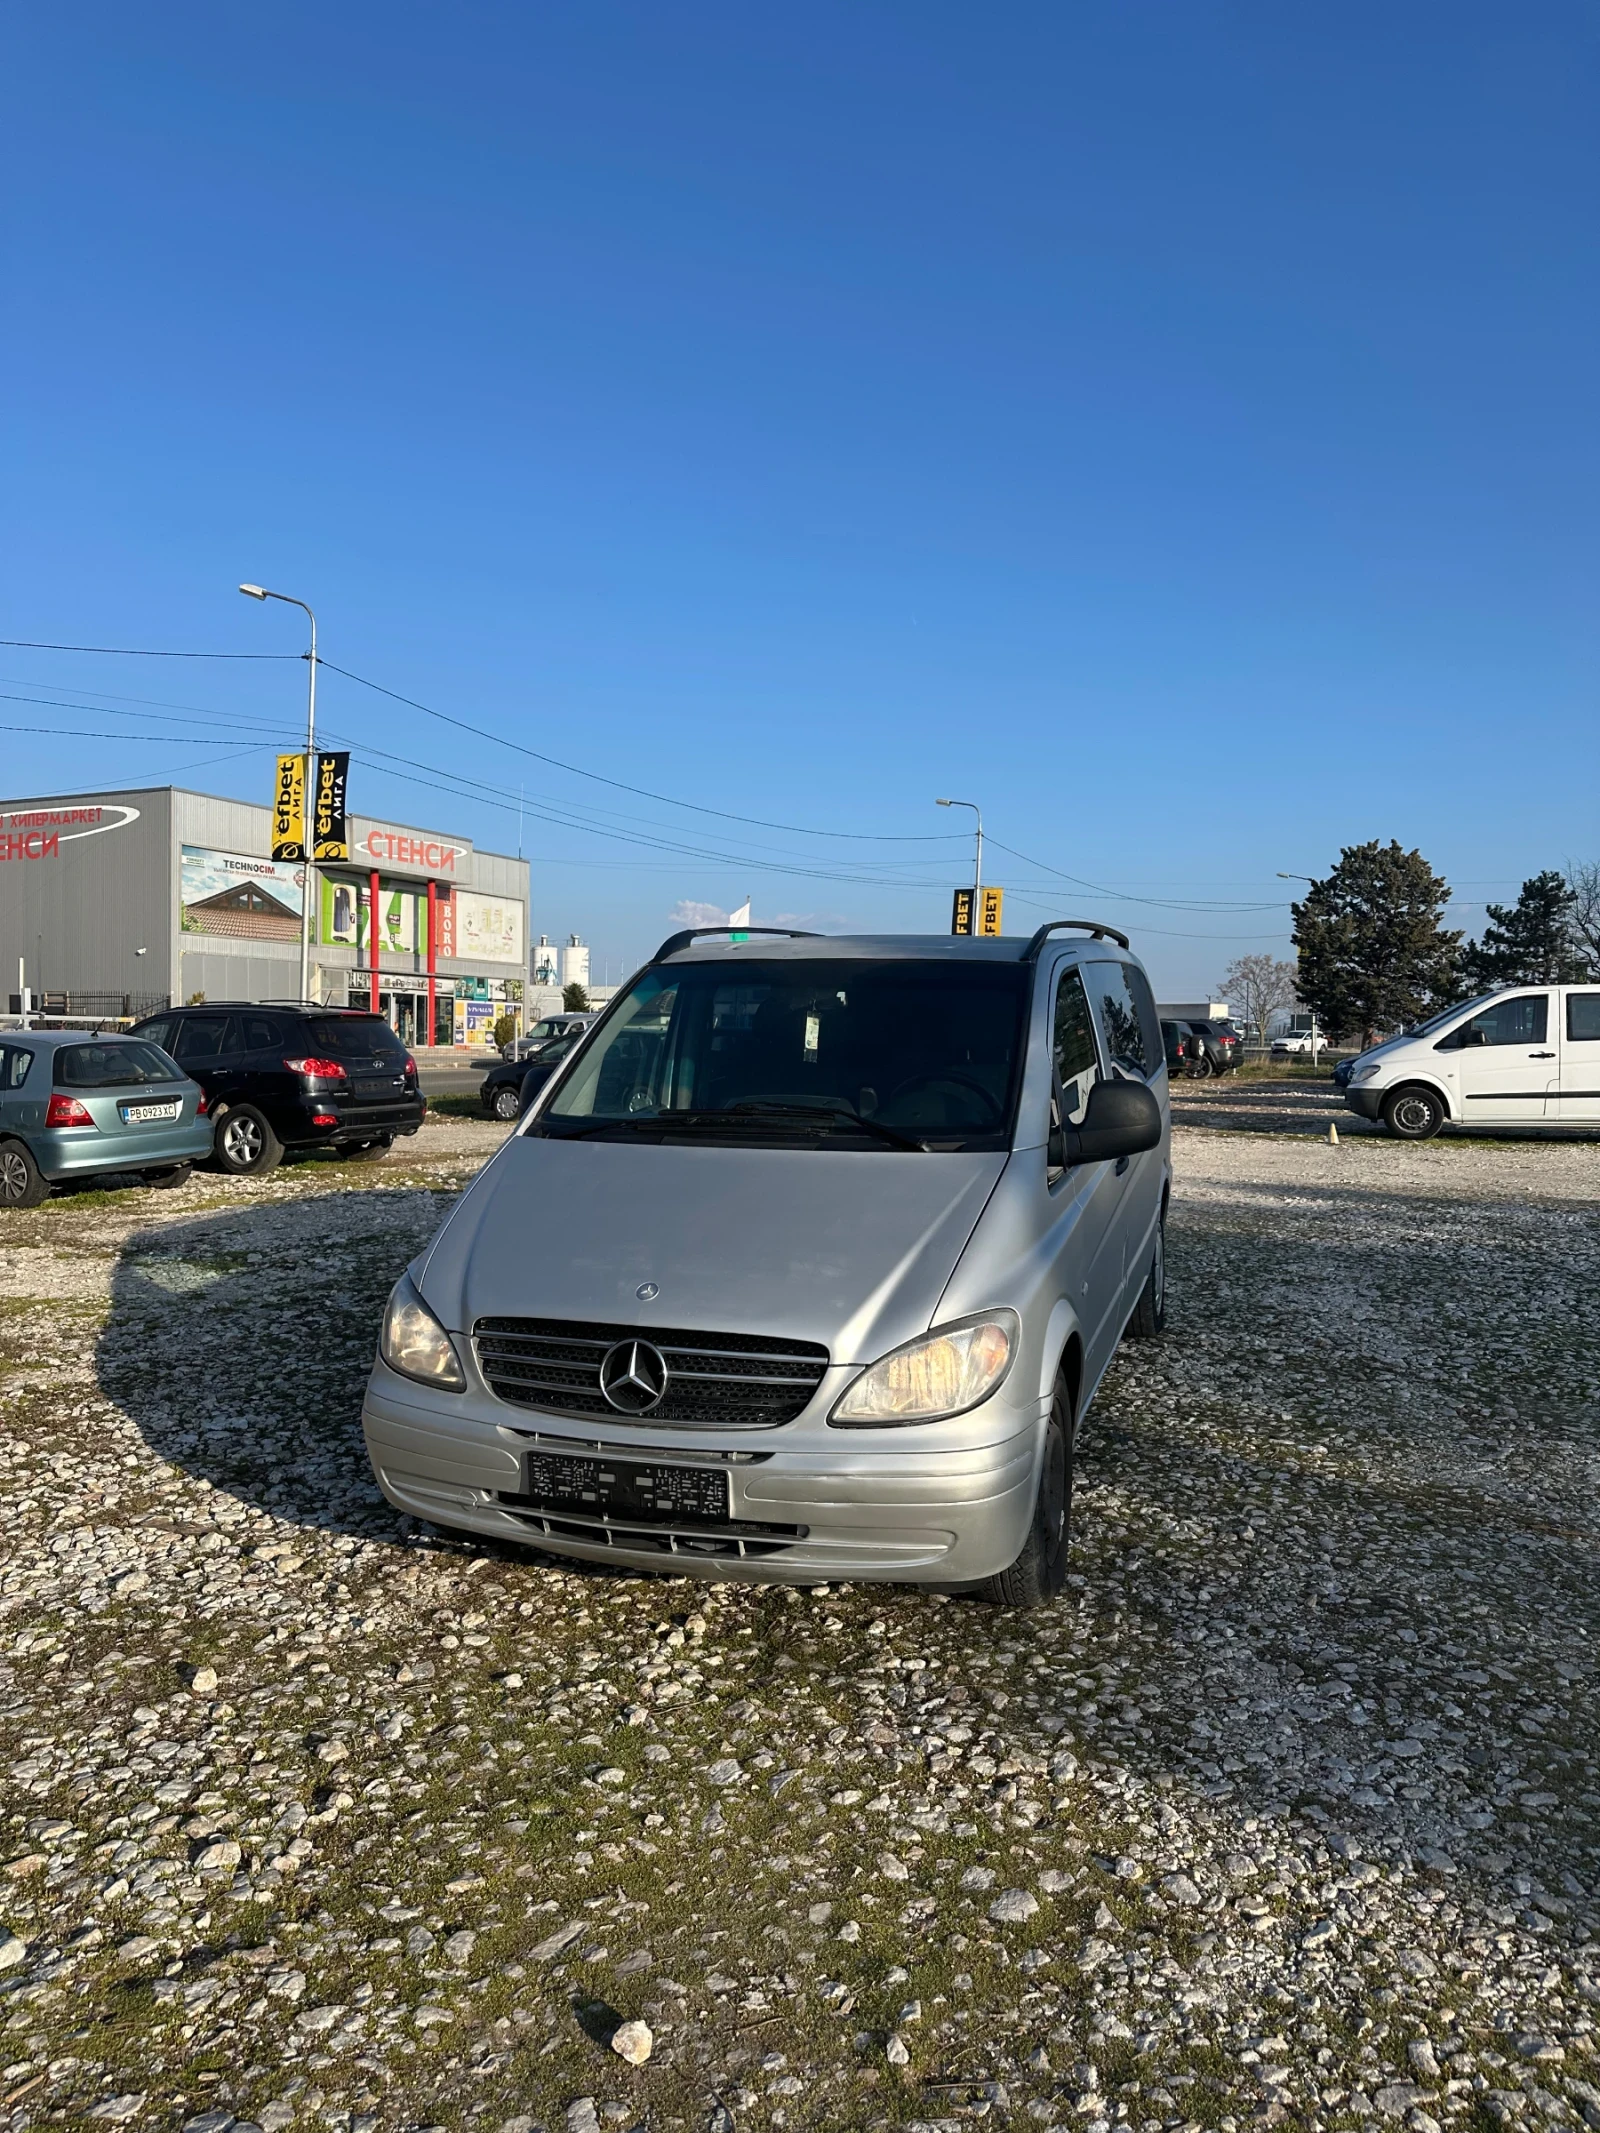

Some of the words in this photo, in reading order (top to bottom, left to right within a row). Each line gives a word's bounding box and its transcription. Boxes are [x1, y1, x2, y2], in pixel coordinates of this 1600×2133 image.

[10, 807, 103, 828] ХИПЕРМАРКЕТ
[276, 761, 295, 835] efbet
[292, 777, 303, 820] ЛИГА
[317, 759, 336, 836] efbet
[333, 775, 344, 820] ЛИГА
[223, 859, 276, 875] TECHNOCIM
[367, 830, 455, 872] СТЕНСИ
[143, 1106, 163, 1118] 0923
